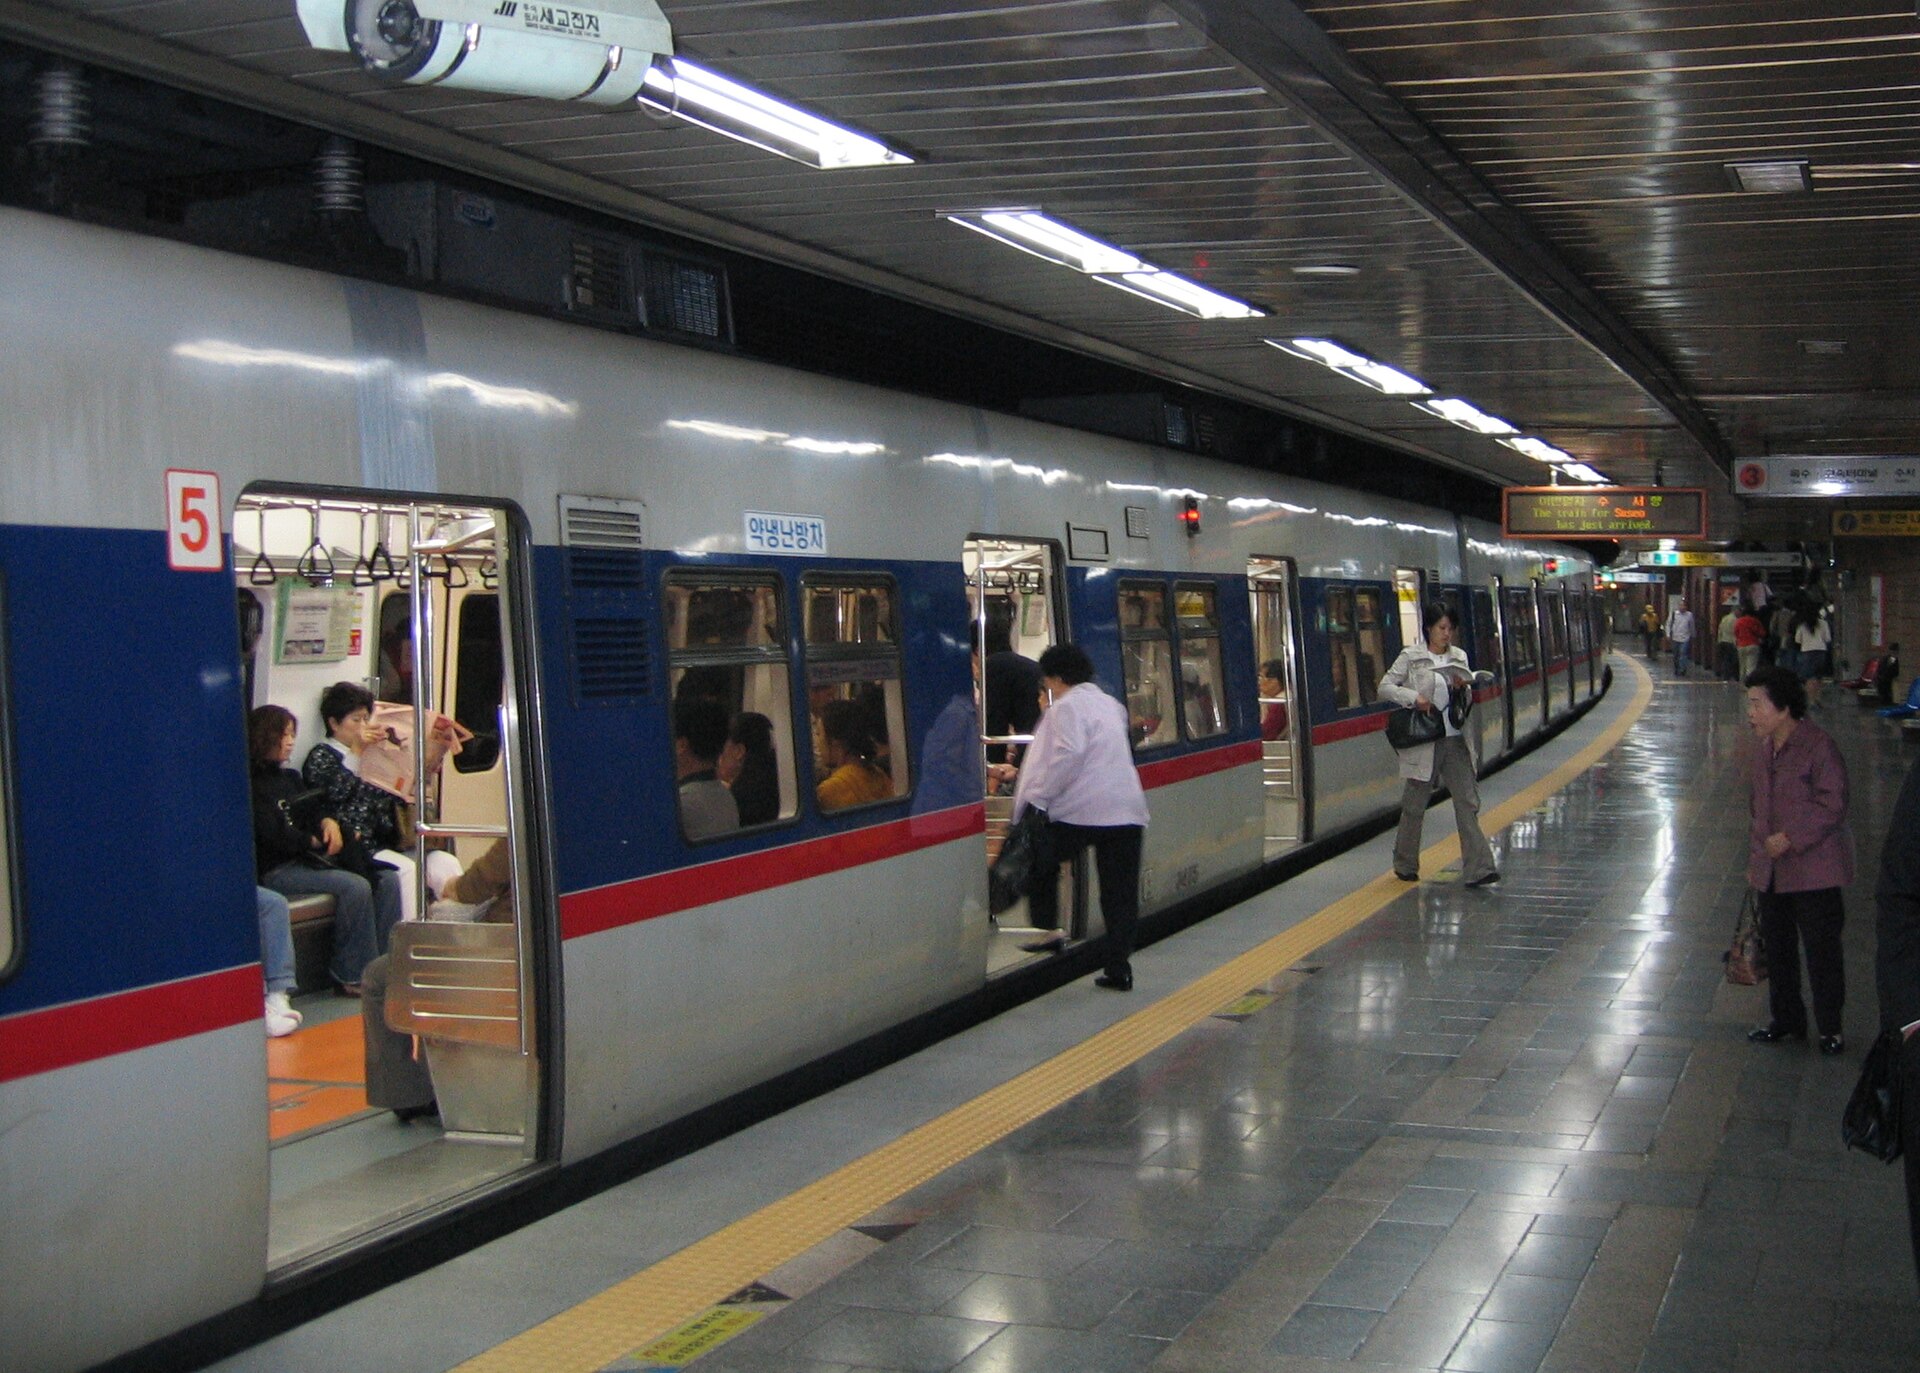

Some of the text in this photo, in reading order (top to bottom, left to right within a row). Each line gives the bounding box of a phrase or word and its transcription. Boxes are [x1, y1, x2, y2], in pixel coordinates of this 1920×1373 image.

[1748, 467, 1760, 485] 3
[180, 487, 209, 552] 5
[1533, 508, 1551, 518] The
[1558, 508, 1587, 518] train
[1592, 508, 1610, 518] for
[749, 516, 824, 550] 약냉난방차
[1556, 519, 1575, 529] has
[1579, 520, 1603, 531] just
